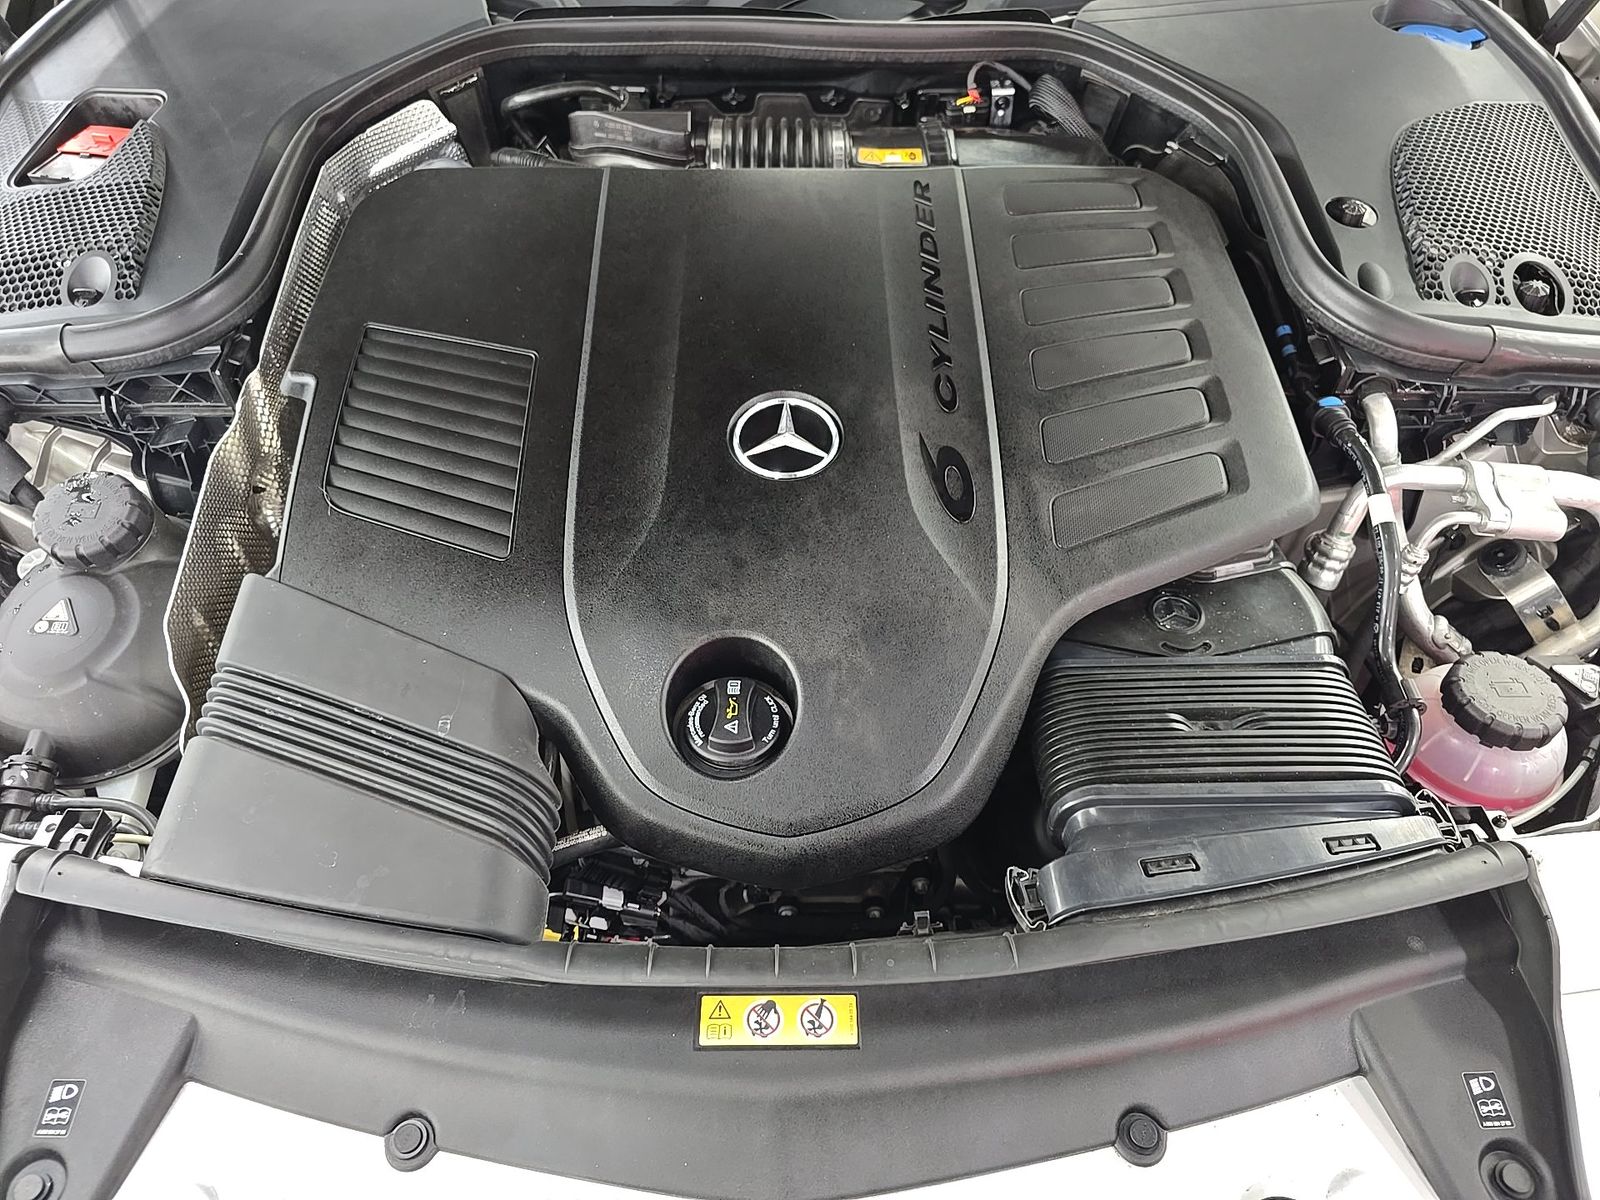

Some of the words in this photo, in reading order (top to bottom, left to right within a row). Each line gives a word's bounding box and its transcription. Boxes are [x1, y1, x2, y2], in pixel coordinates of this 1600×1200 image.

[913, 178, 959, 414] CYLINDER
[918, 431, 978, 525] 6
[694, 699, 709, 738] recommended
[764, 695, 779, 713] CLICK
[771, 714, 780, 729] until
[686, 701, 704, 747] Mercedes-Benz
[761, 728, 776, 743] Turn
